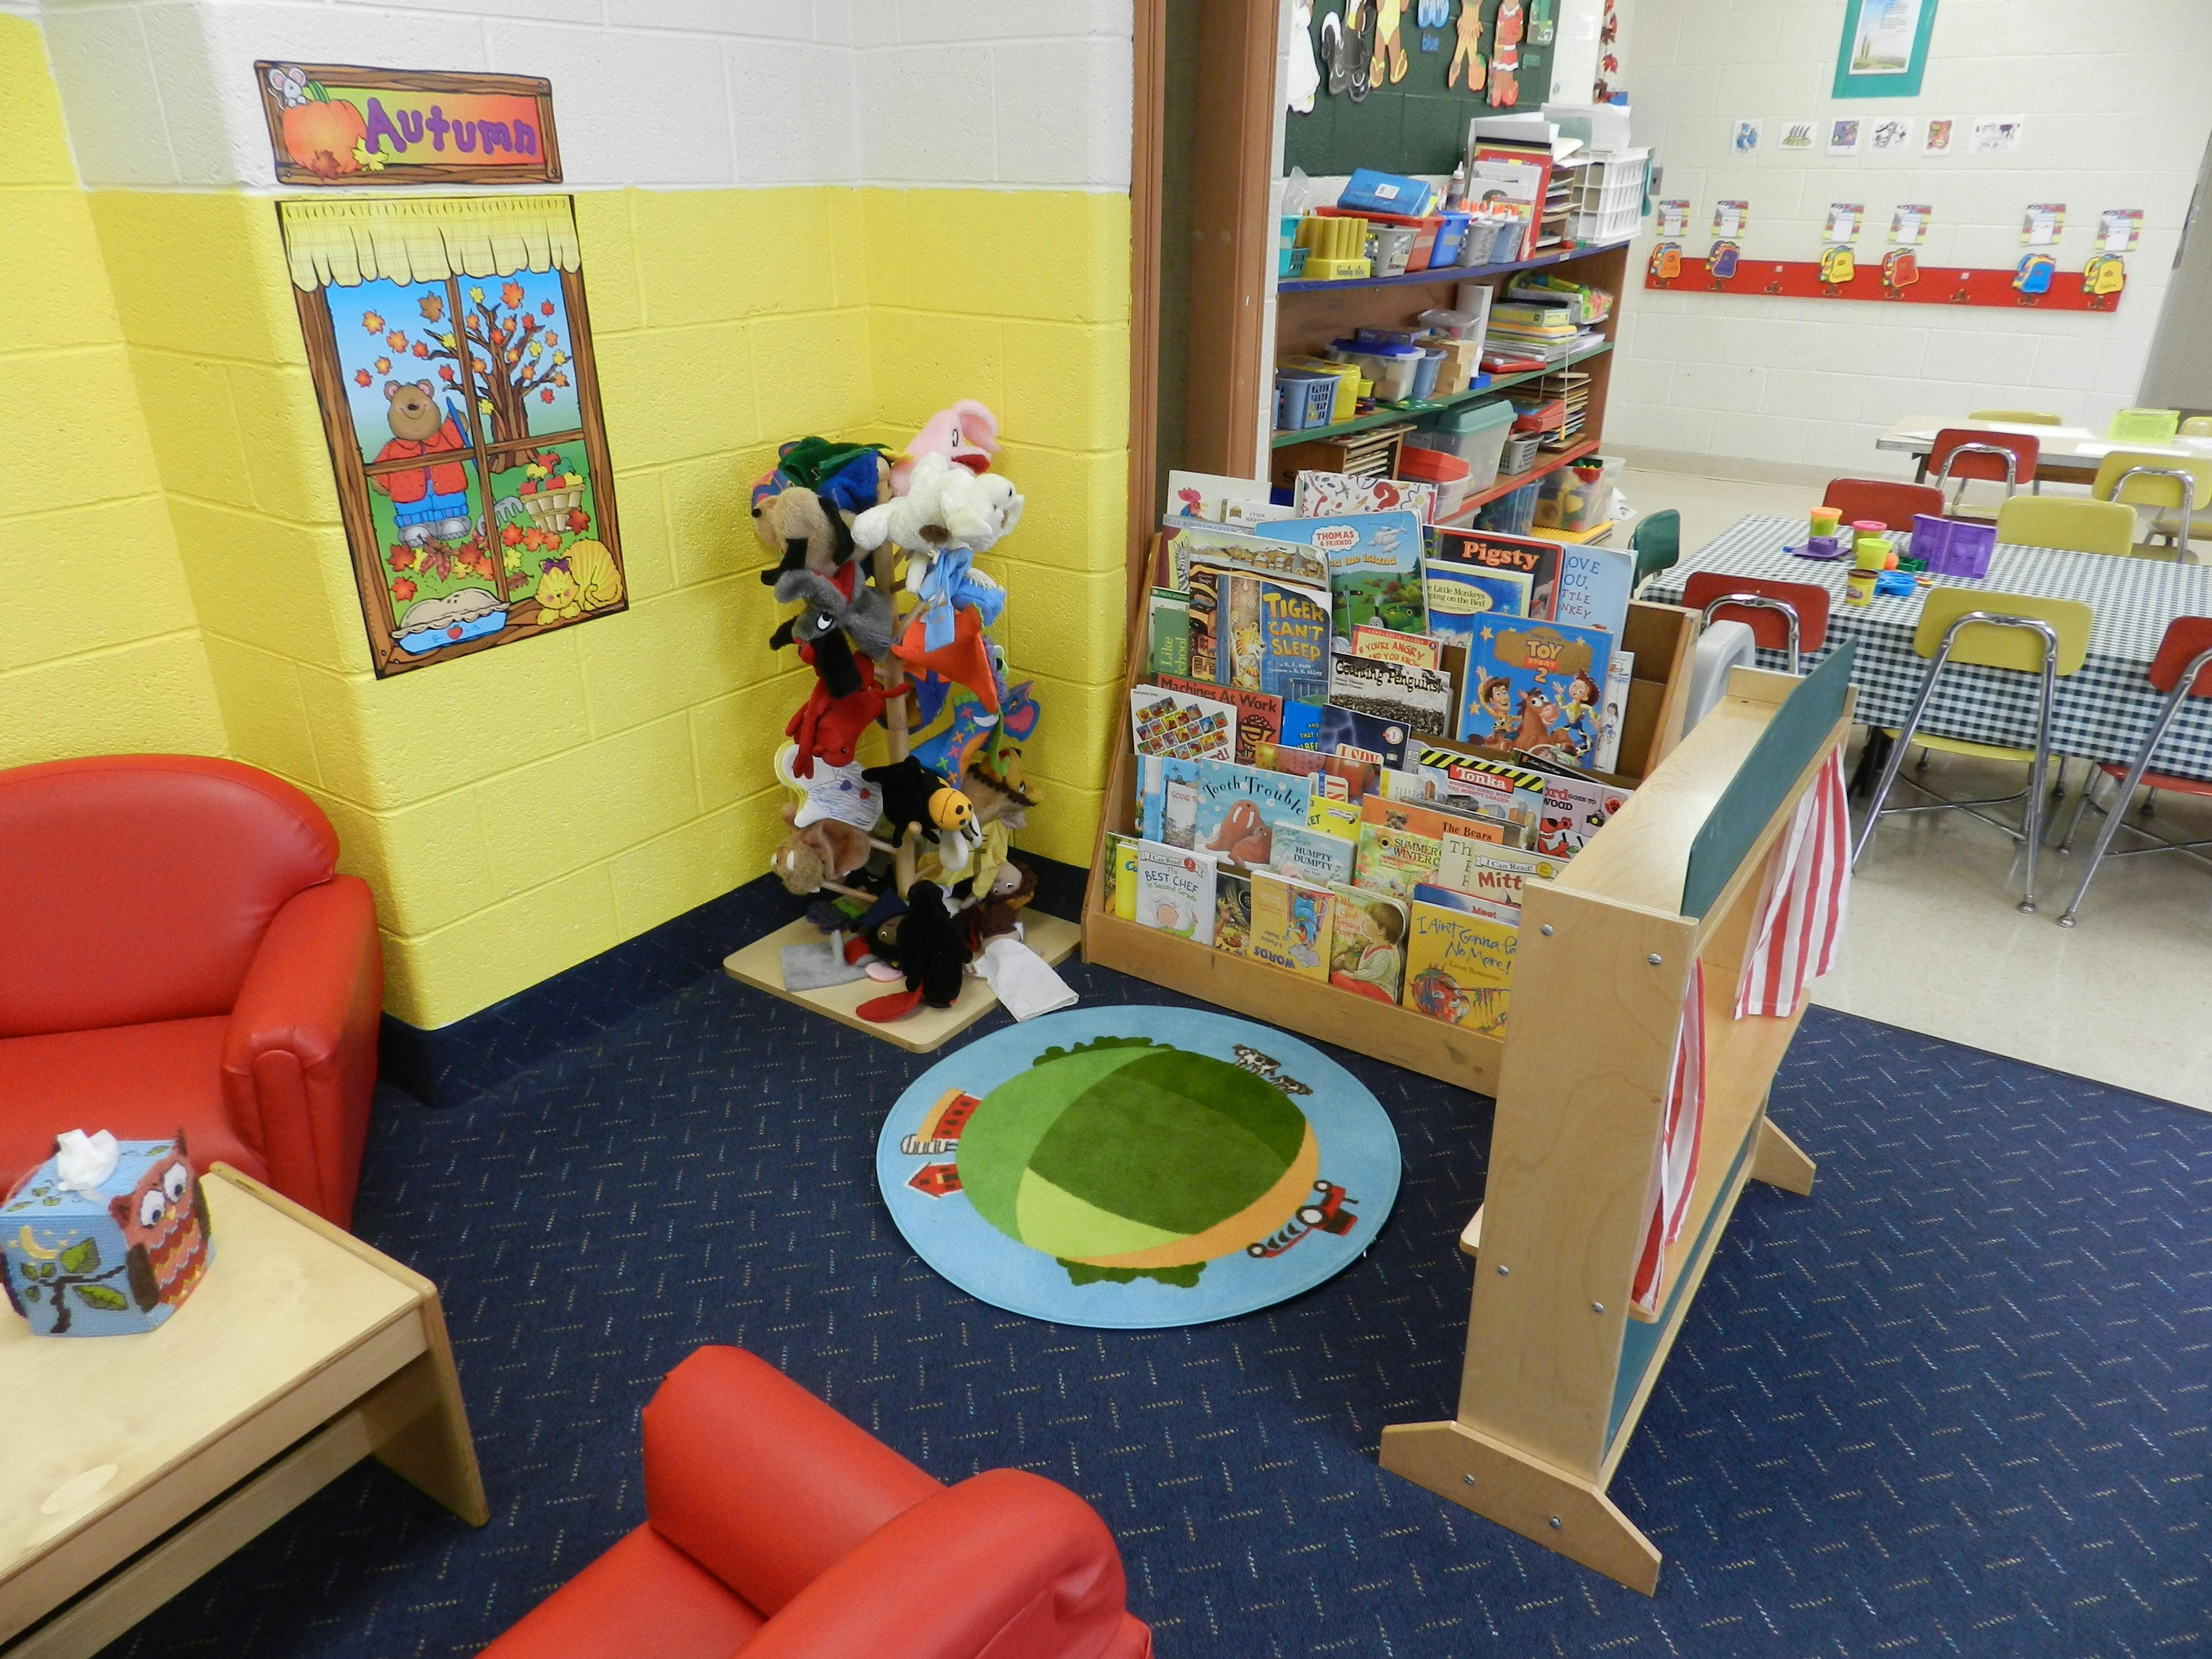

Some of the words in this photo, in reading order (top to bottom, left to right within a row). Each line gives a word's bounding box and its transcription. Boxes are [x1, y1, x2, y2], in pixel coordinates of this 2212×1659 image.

[365, 97, 537, 156] Autumn
[1316, 531, 1355, 540] THOMAS
[1343, 556, 1360, 566] the
[1363, 554, 1397, 566] Island
[1462, 540, 1540, 571] Pigsty
[1434, 585, 1453, 593] Little
[1454, 588, 1485, 599] Monkeys
[1262, 593, 1325, 623] TIGER
[1471, 598, 1485, 607] Bed
[1269, 621, 1324, 641] CAN'T
[1368, 630, 1401, 639] SCHOLASTIC
[1161, 637, 1173, 667] Like
[1271, 638, 1321, 662] SLEEP
[1392, 641, 1425, 660] ANGRY
[1526, 640, 1564, 660] TOY
[1336, 659, 1383, 686] Counting
[1387, 668, 1442, 693] Penguins!
[1534, 666, 1548, 684] 2
[1161, 677, 1216, 701] Machines
[1219, 691, 1235, 705] At
[1238, 694, 1277, 713] Work
[1392, 731, 1396, 740] 1
[1456, 766, 1506, 790] Tonka
[1171, 791, 1190, 800] GOING
[1202, 775, 1240, 800] Tooth
[1244, 775, 1305, 816] Trouble
[1569, 794, 1587, 802] GOES
[1442, 821, 1461, 833] The
[1463, 826, 1493, 841] Bears
[1296, 846, 1332, 862] HUMPTY
[1394, 838, 1438, 857] SUMMER
[1394, 847, 1431, 864] WINTER
[1167, 866, 1178, 874] The
[1294, 854, 1333, 870] DUMPTY
[1491, 861, 1507, 869] Can
[1510, 863, 1532, 872] Read!
[1145, 870, 1170, 882] BEST
[1173, 875, 1198, 893] CHEF
[1478, 872, 1522, 890] Mitt
[1154, 882, 1176, 892] Second
[1177, 888, 1197, 902] Grade
[1416, 916, 1428, 934] I
[1460, 928, 1500, 954] Gonna
[1254, 946, 1295, 969] WORDS
[1444, 941, 1465, 958] No
[1466, 948, 1511, 975] More!
